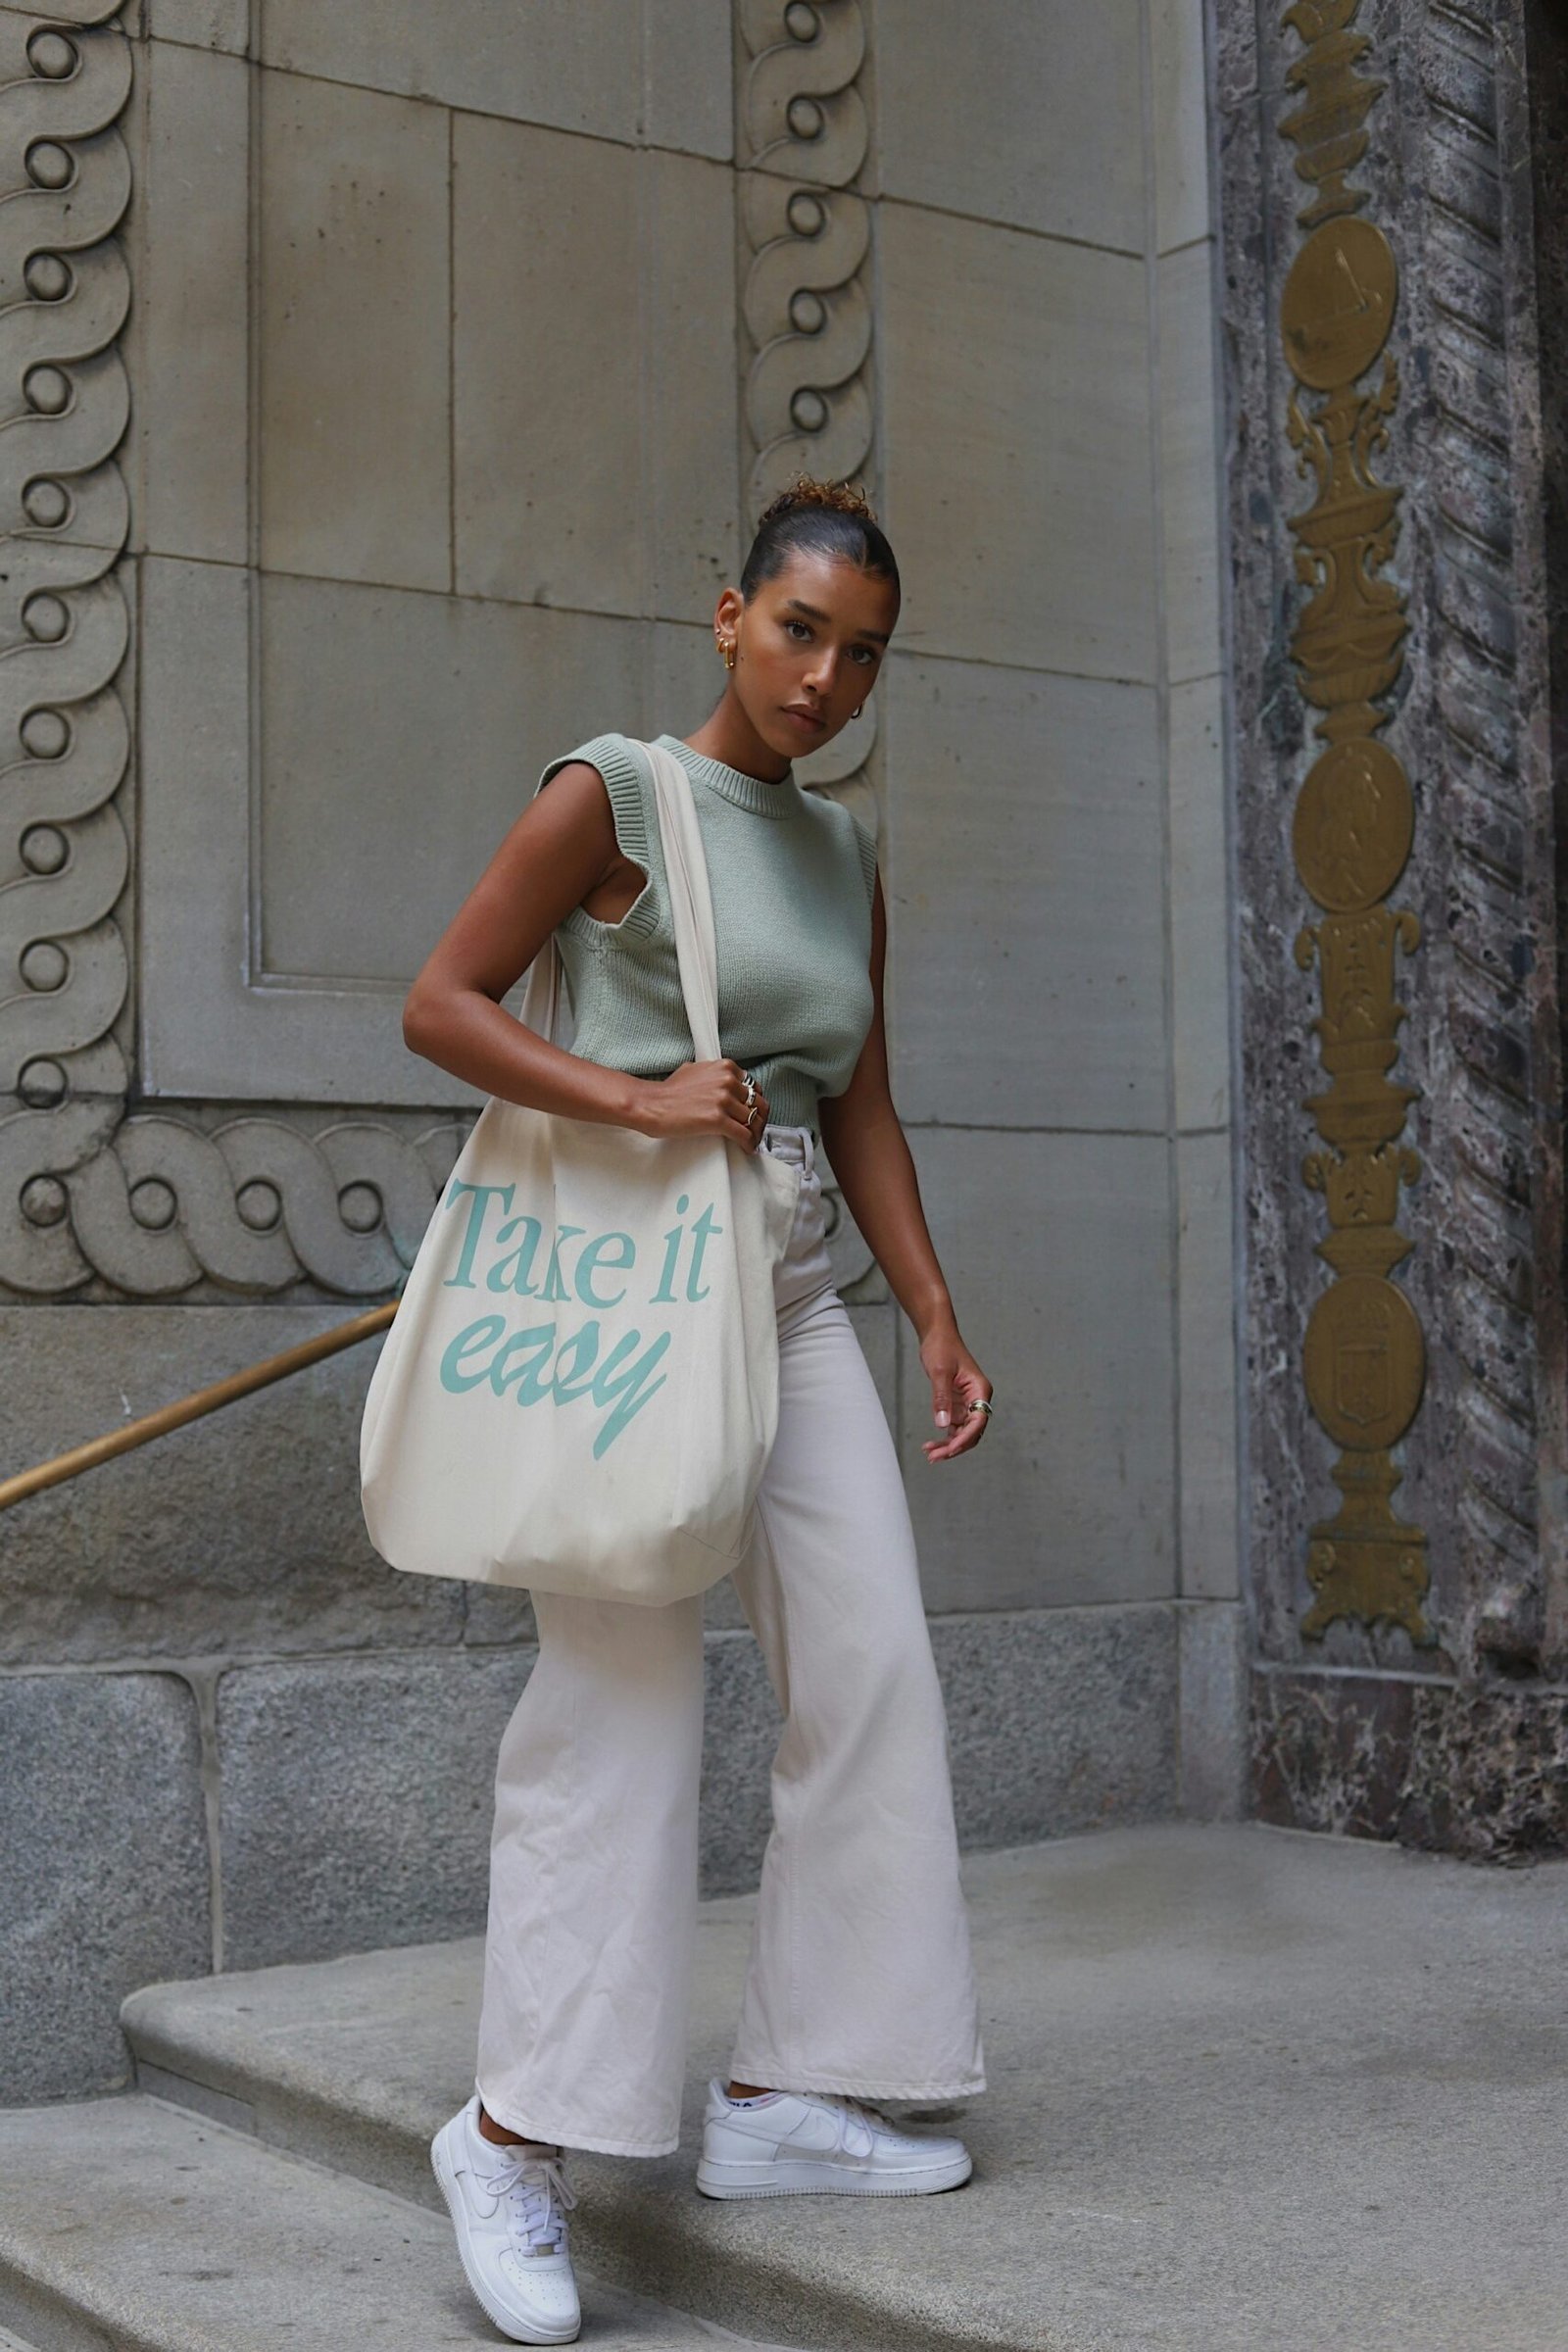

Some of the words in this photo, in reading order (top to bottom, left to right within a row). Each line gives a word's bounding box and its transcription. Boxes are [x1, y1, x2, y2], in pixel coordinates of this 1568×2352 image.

[444, 1178, 637, 1309] Take
[649, 1194, 723, 1304] it
[439, 1314, 671, 1461] easy
